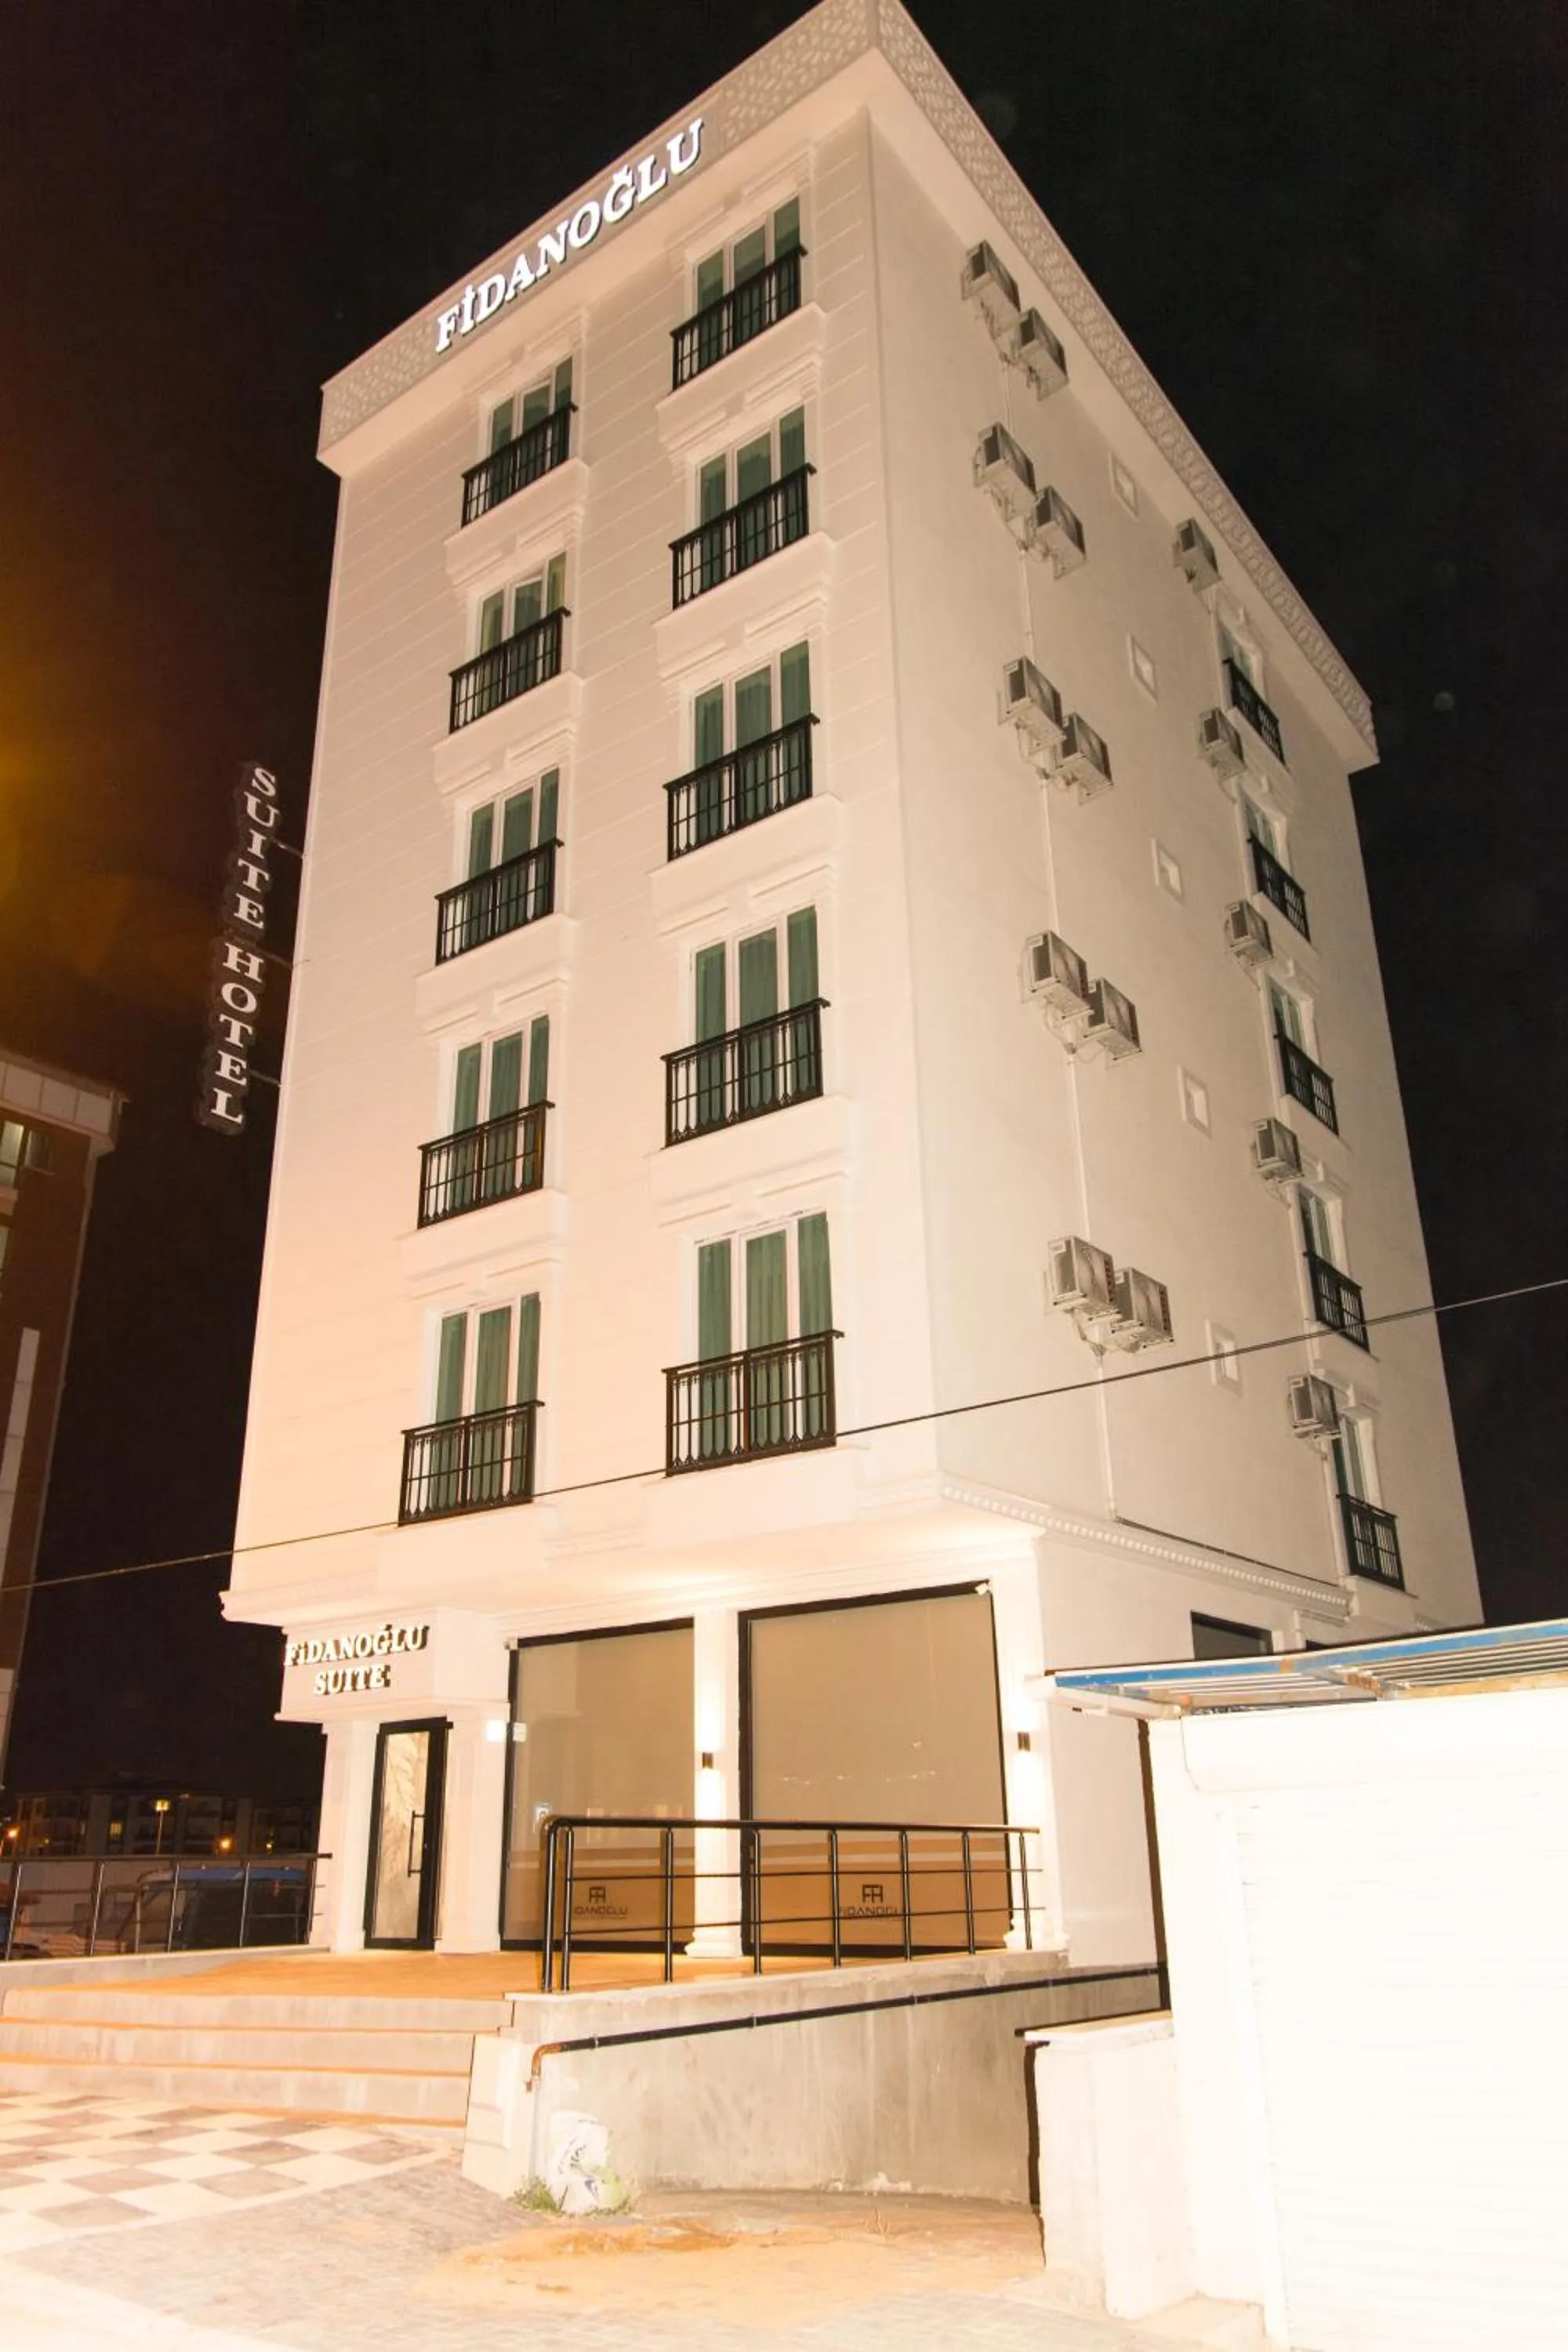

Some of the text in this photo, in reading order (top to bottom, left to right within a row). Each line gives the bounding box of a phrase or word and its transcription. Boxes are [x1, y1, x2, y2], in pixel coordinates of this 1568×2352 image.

[435, 118, 704, 352] FİDANOĞLU
[211, 768, 278, 1123] SUITE HOTEL
[314, 1664, 390, 1696] SUITE
